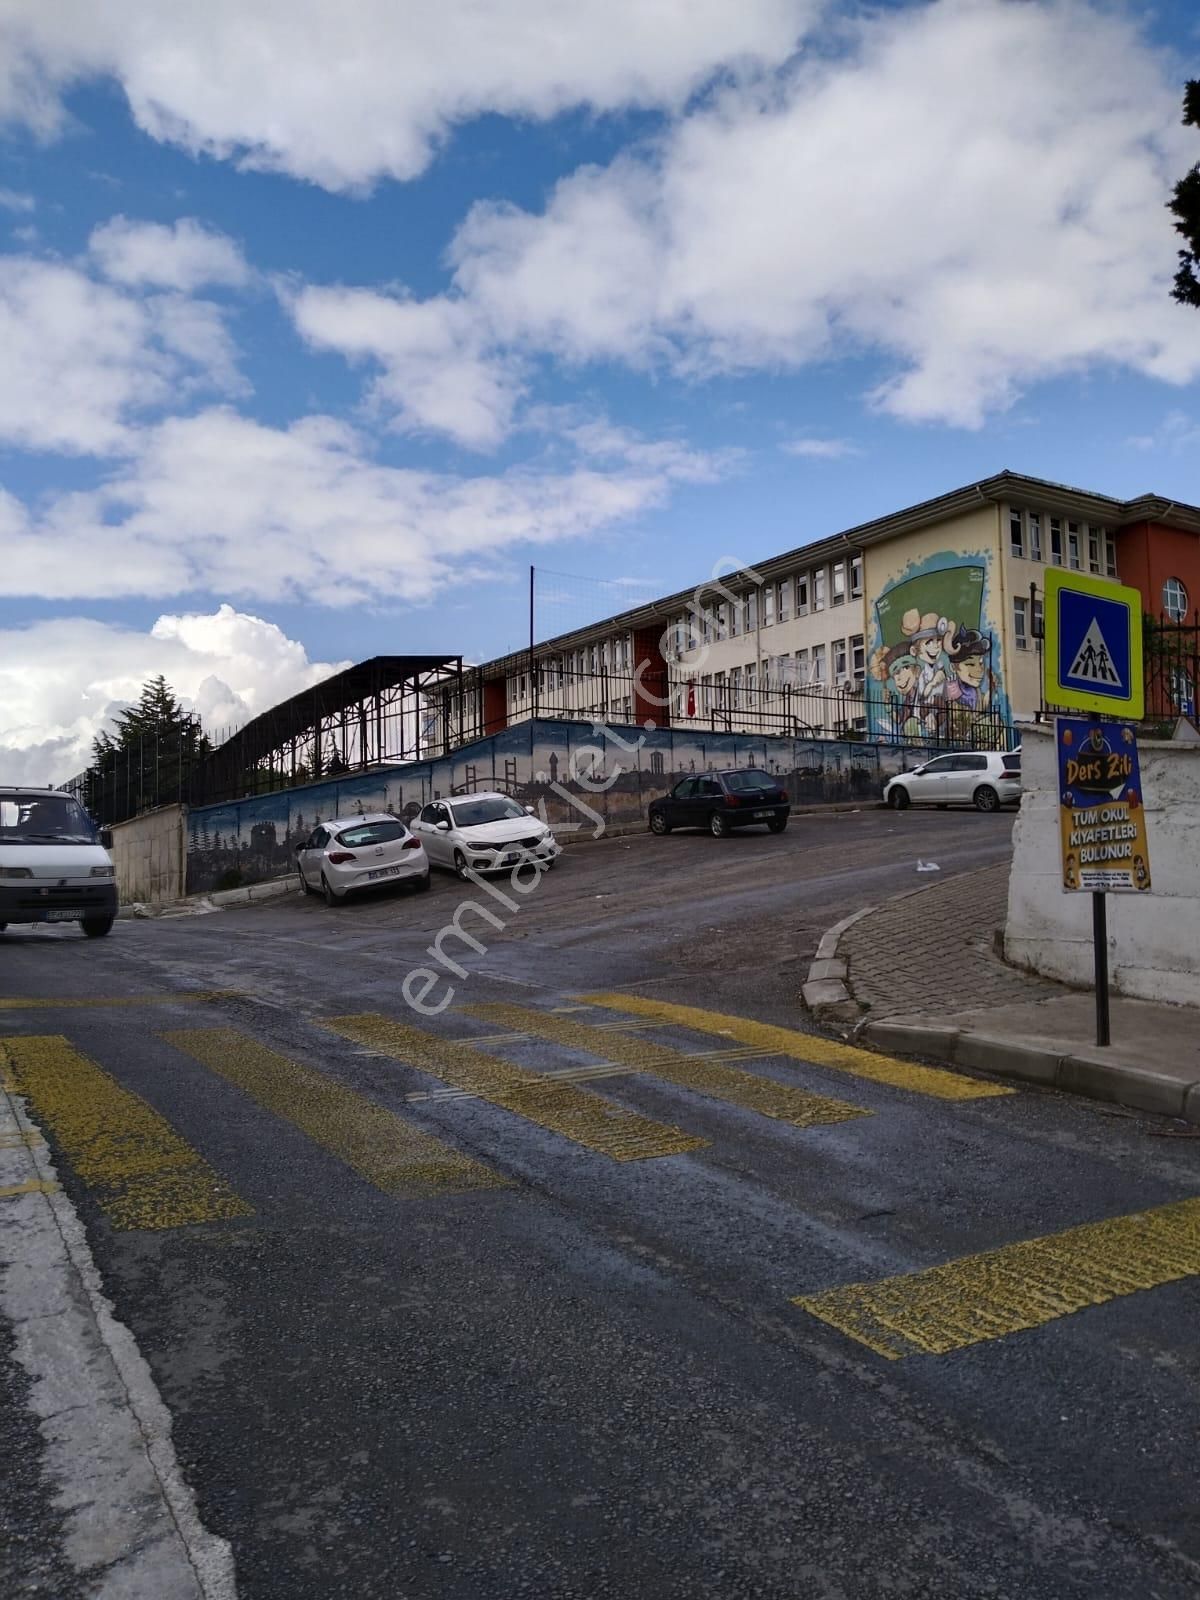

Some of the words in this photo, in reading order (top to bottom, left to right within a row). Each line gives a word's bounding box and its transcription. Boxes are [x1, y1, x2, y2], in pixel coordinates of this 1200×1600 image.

[1067, 759, 1101, 785] Ders
[1107, 753, 1132, 779] Zili
[1100, 808, 1130, 822] OKUL
[1080, 844, 1132, 863] BULUNUR
